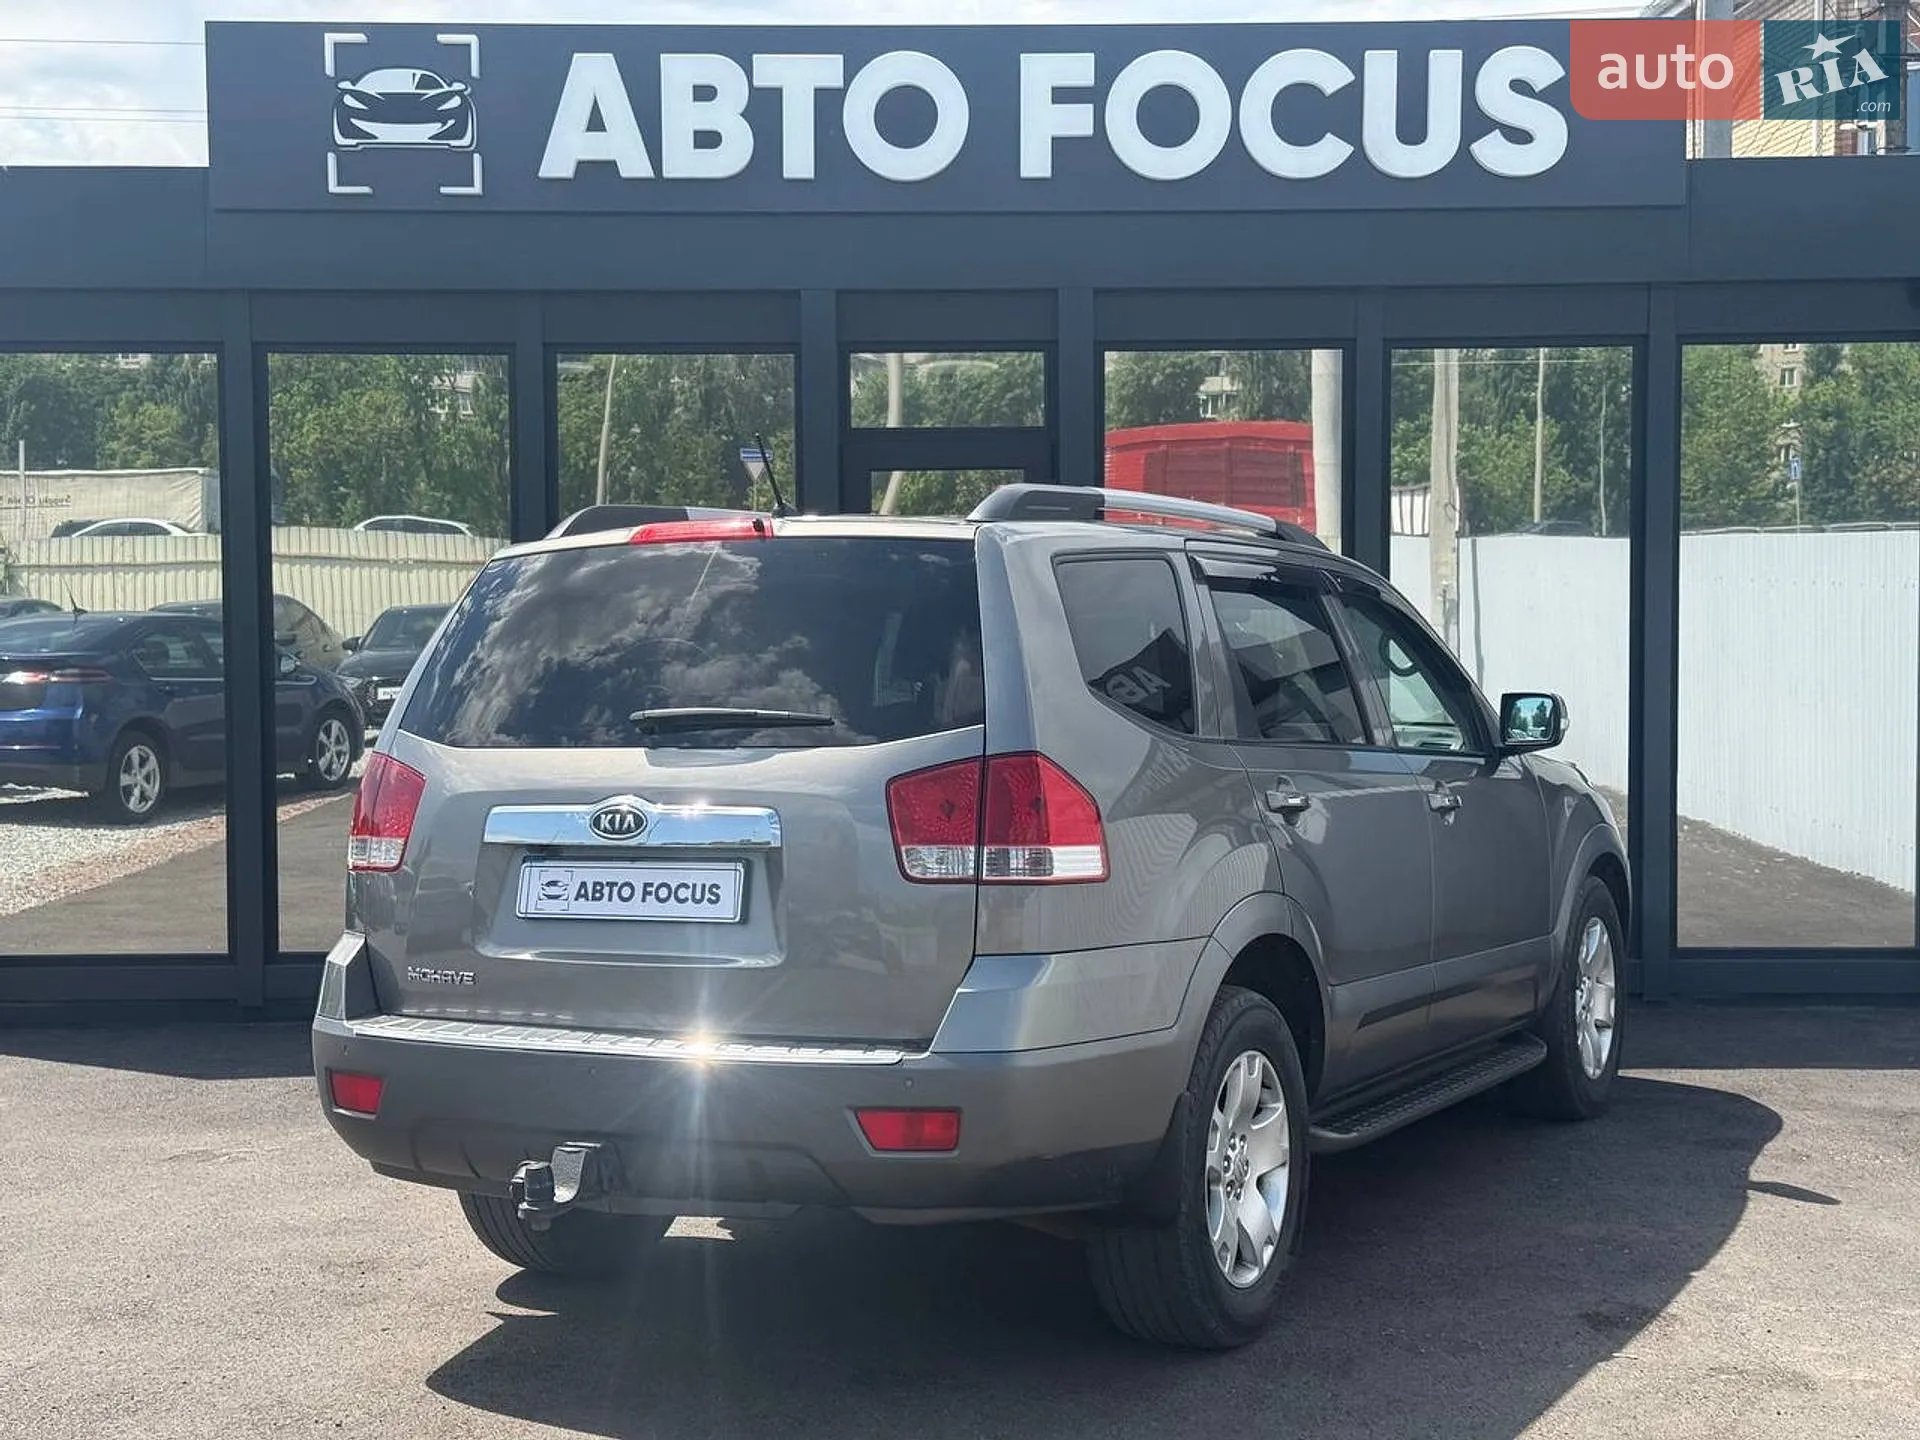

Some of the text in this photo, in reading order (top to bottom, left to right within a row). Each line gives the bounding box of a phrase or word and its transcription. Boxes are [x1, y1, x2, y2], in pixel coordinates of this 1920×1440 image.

[537, 45, 1569, 182] АВТО FOCUS
[599, 812, 636, 831] KIA
[574, 880, 722, 906] АВТО FOCUS
[407, 966, 475, 985] MOHAVE
